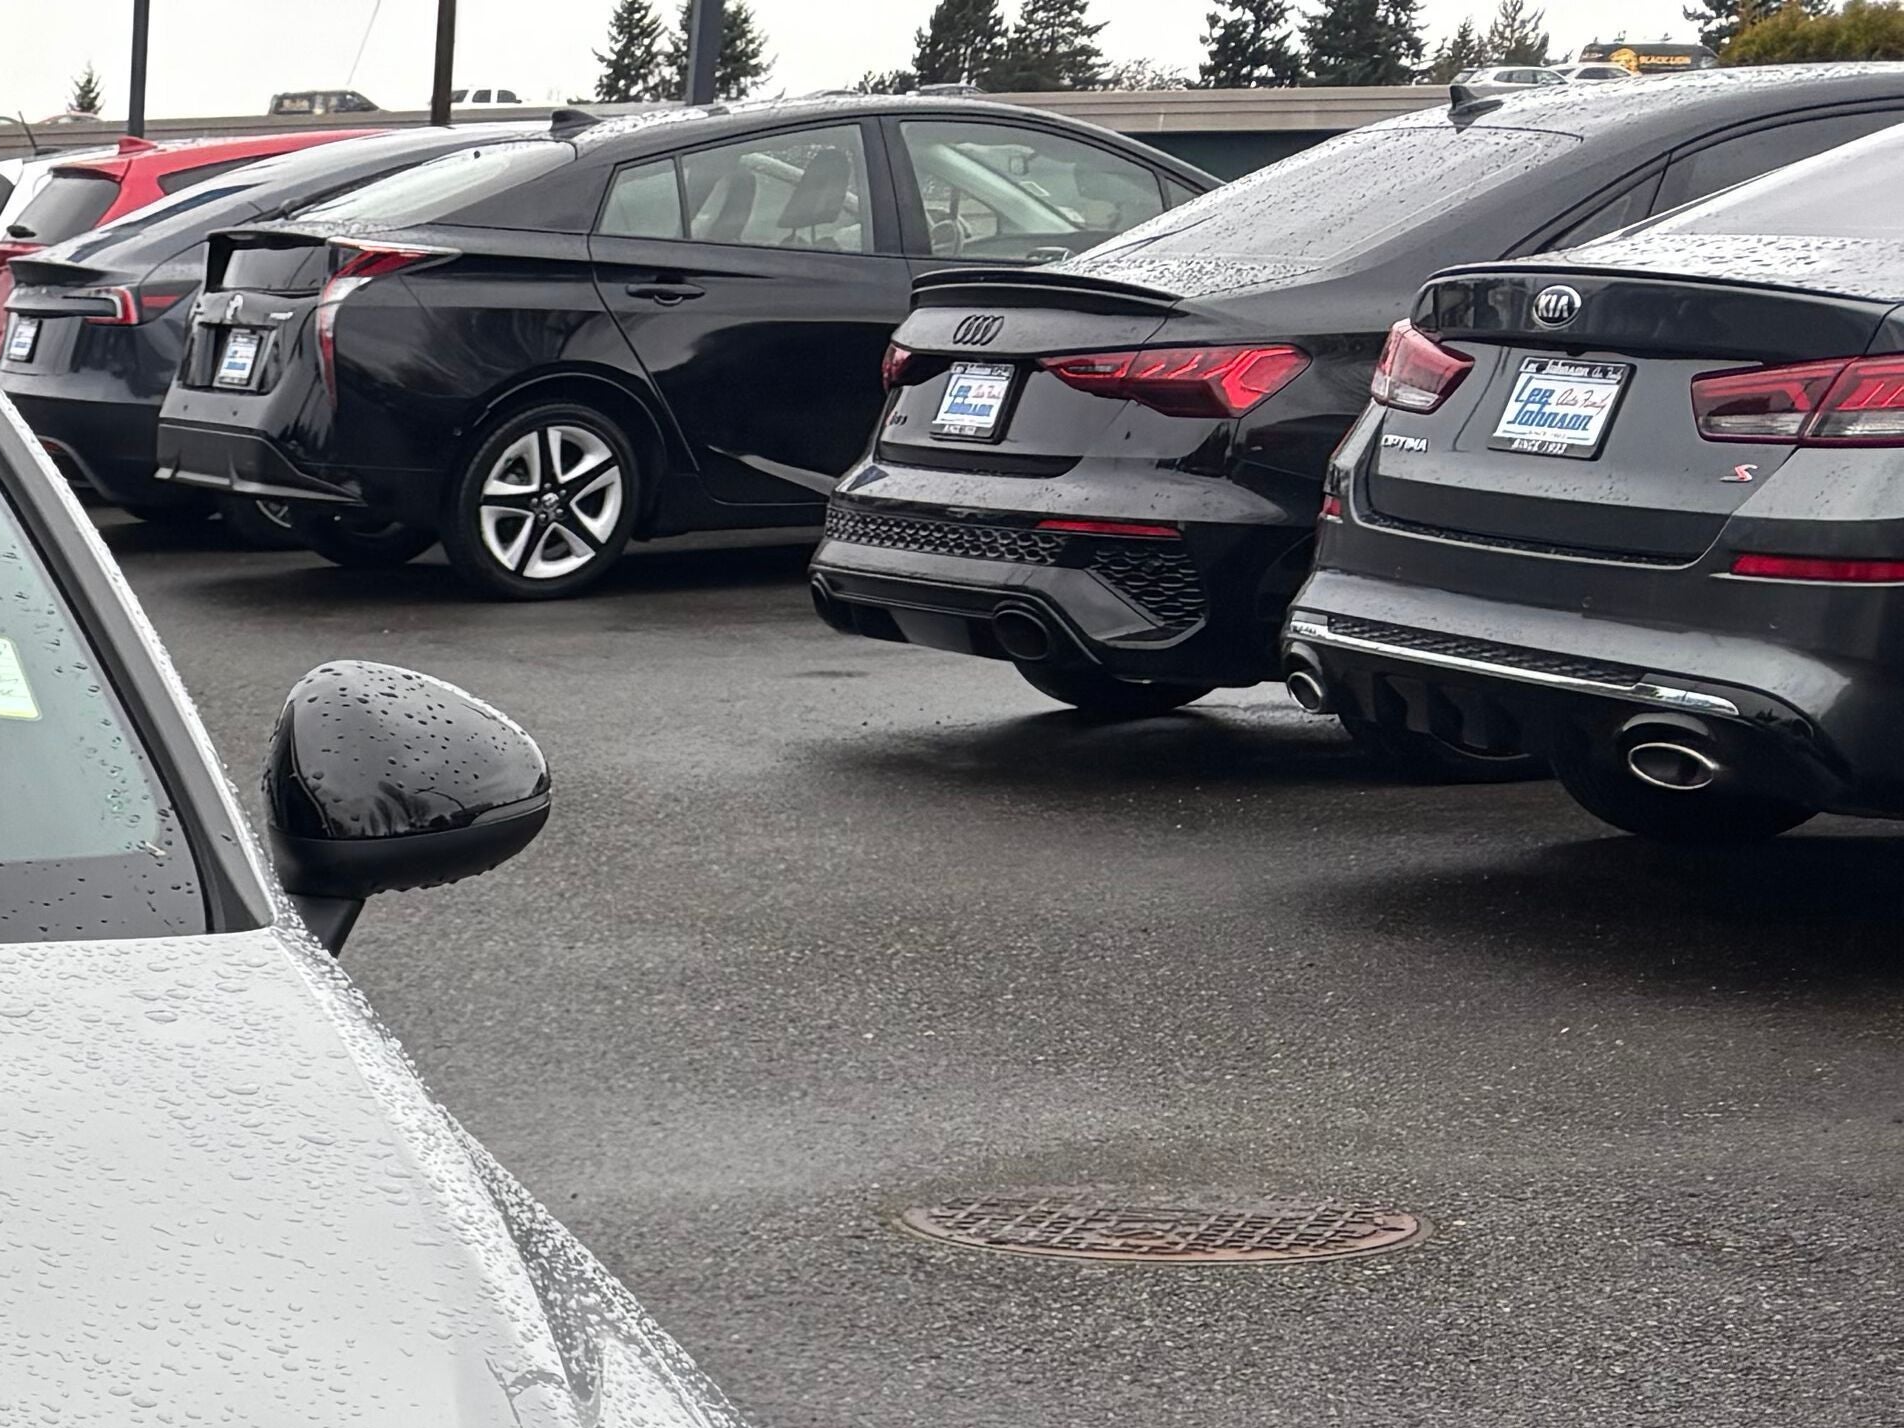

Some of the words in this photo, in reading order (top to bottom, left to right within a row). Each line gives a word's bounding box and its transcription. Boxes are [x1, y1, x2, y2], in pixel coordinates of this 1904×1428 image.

[1538, 294, 1569, 318] KIA
[1514, 376, 1555, 405] Lee
[1506, 402, 1593, 431] Johnson
[1382, 434, 1427, 451] OPTIMA
